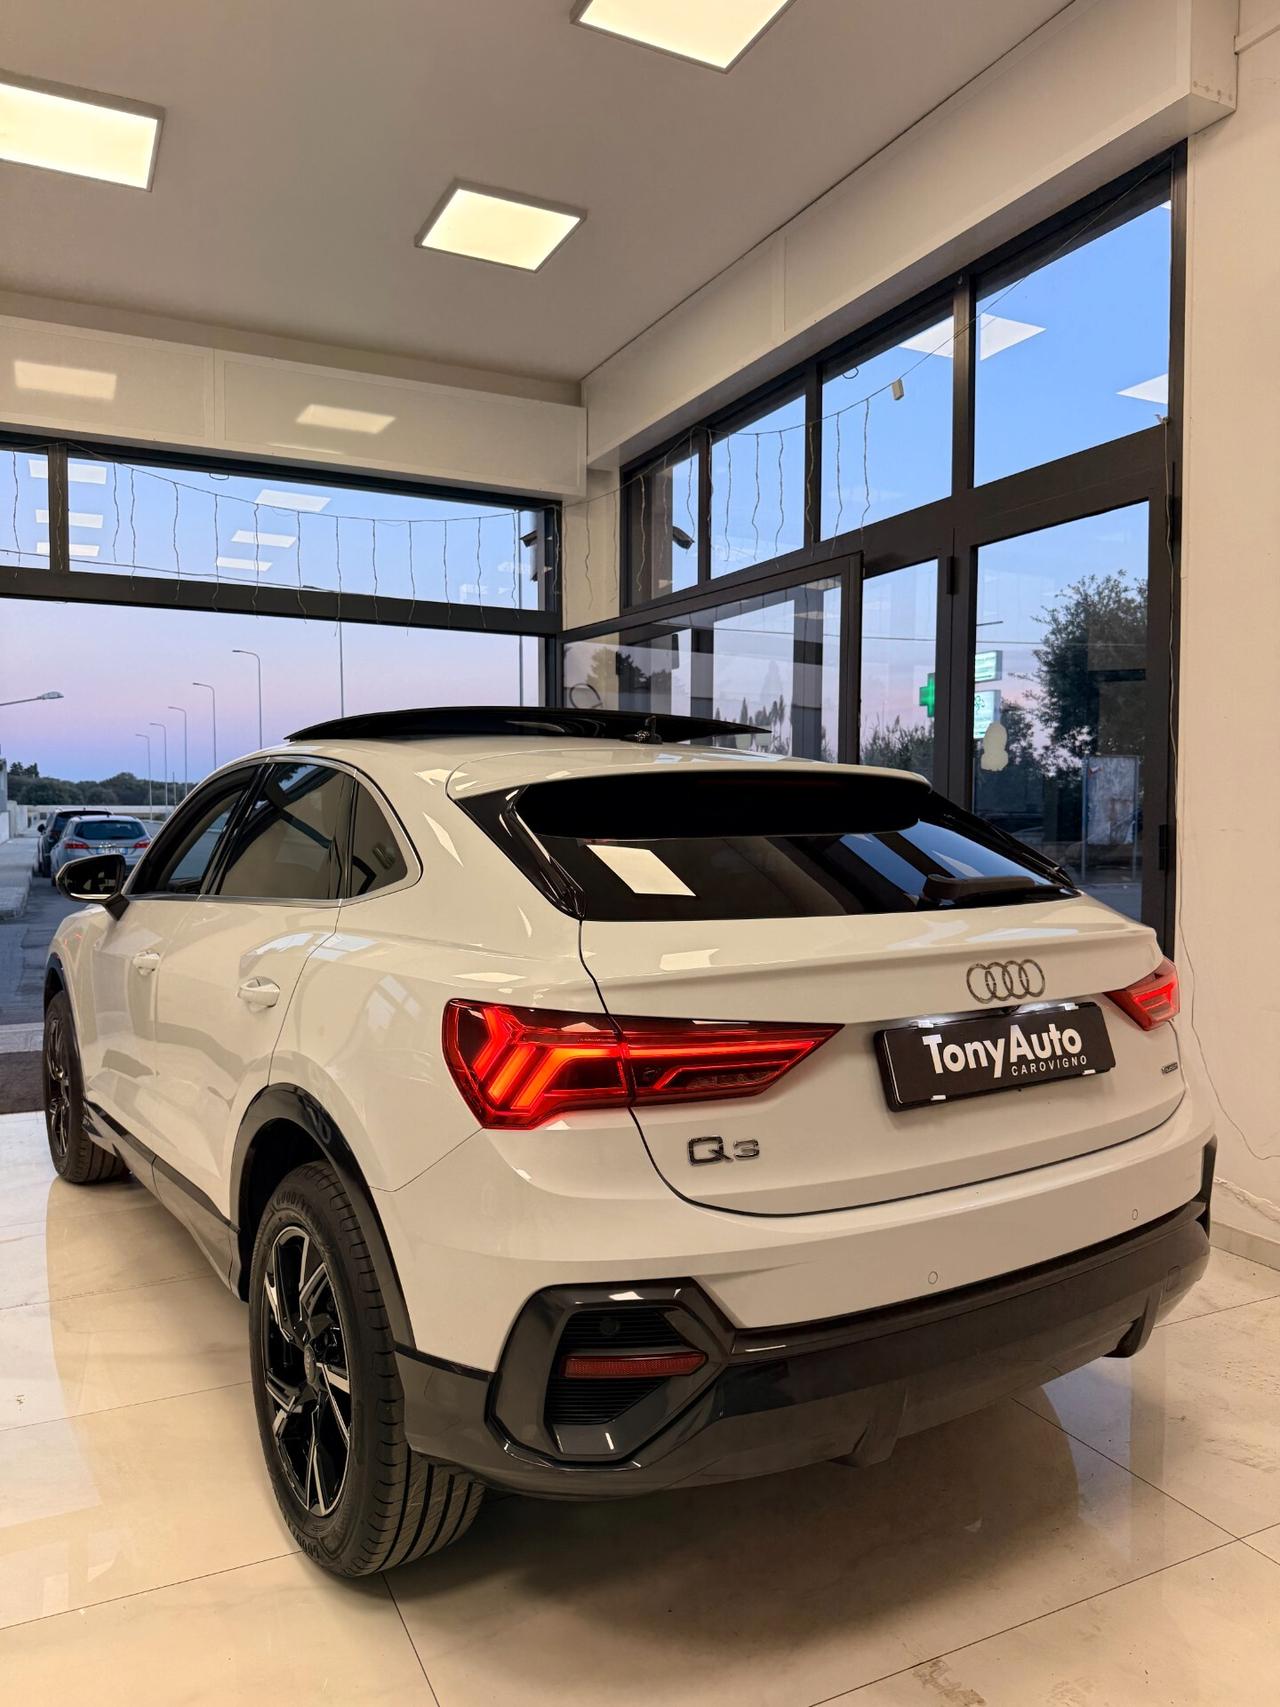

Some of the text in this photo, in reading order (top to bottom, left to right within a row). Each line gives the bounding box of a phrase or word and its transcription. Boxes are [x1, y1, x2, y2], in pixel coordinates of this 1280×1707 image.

[922, 1024, 1082, 1078] TonyAuto
[1011, 1055, 1087, 1076] CAROVIGNO
[687, 1136, 760, 1165] Q3
